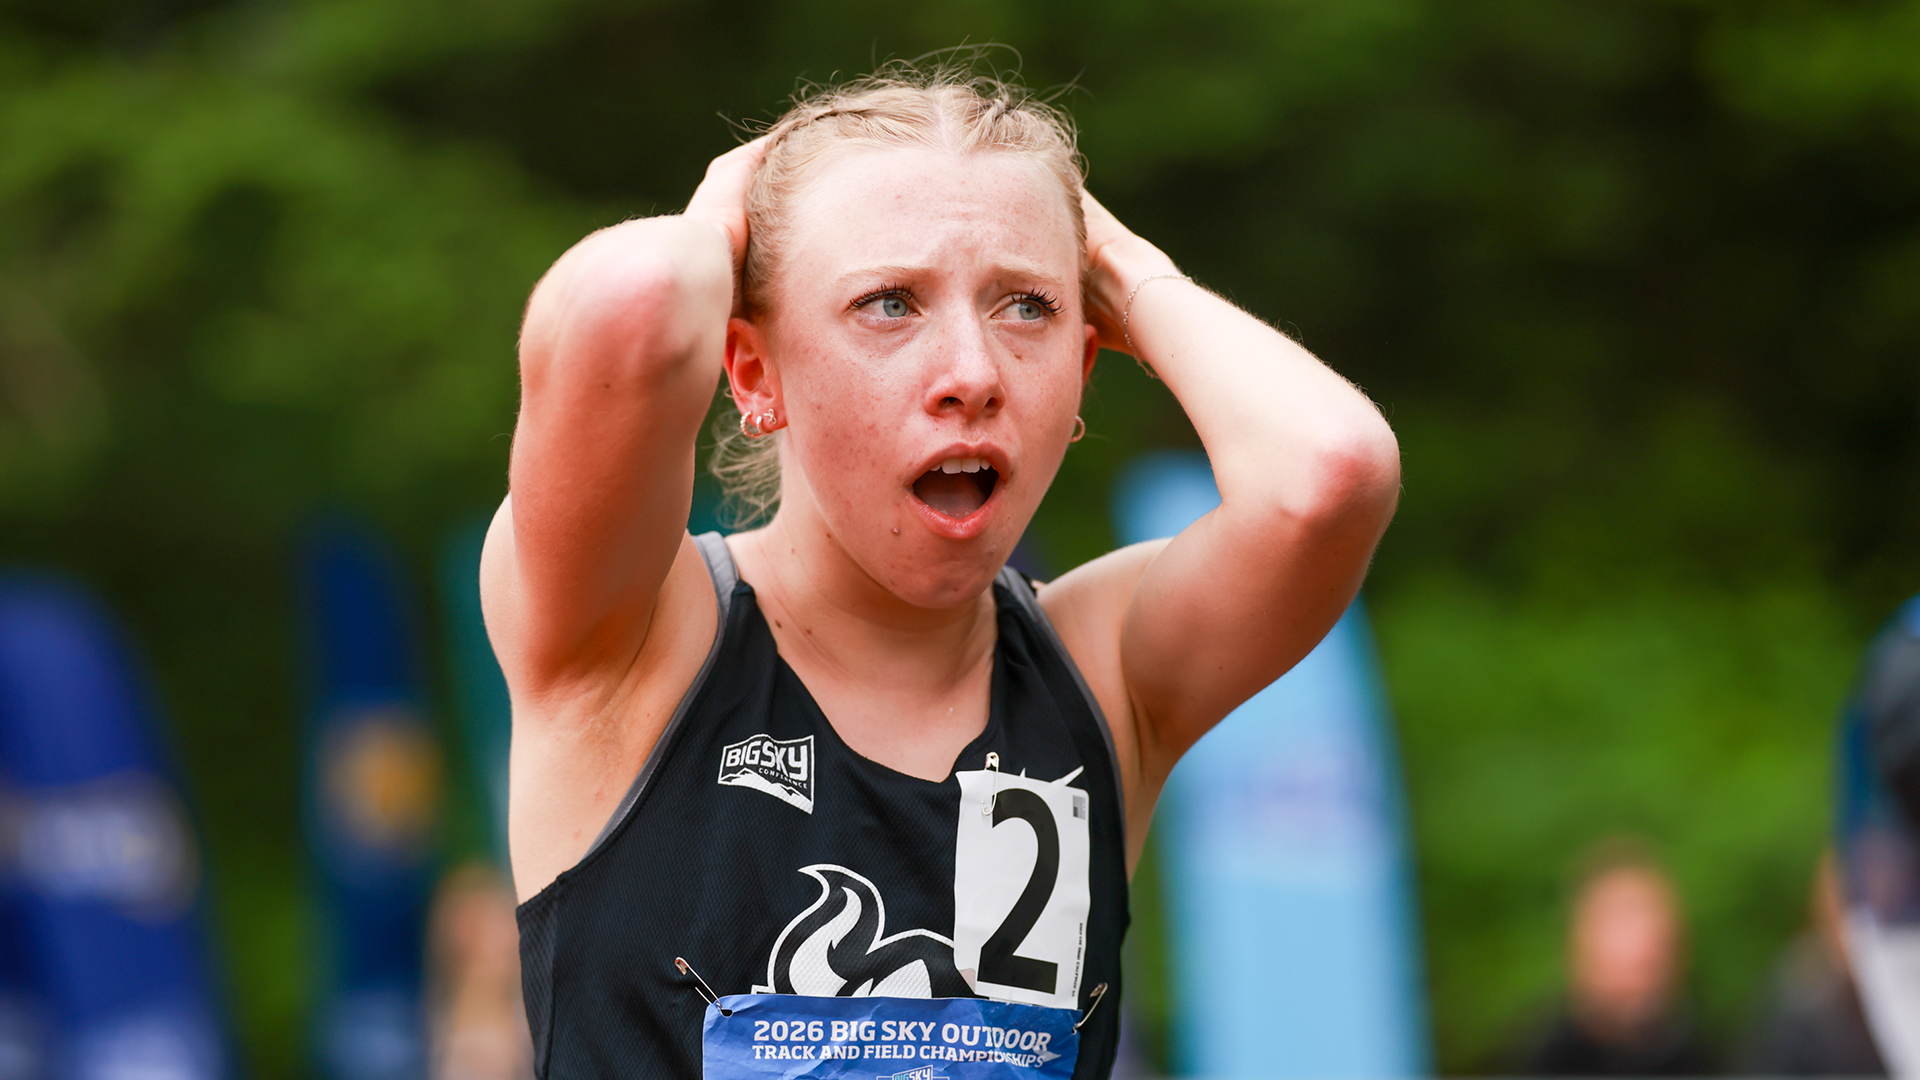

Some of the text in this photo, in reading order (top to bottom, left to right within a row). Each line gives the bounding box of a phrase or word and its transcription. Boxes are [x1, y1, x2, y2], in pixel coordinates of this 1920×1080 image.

[759, 767, 808, 789] CONFERENCE
[976, 788, 1060, 995] 2
[754, 1020, 1052, 1053] 2026 BIG SKY OUTDOOR
[752, 1045, 816, 1060] TRACK
[819, 1045, 861, 1060] AND
[863, 1045, 916, 1060] FIELD
